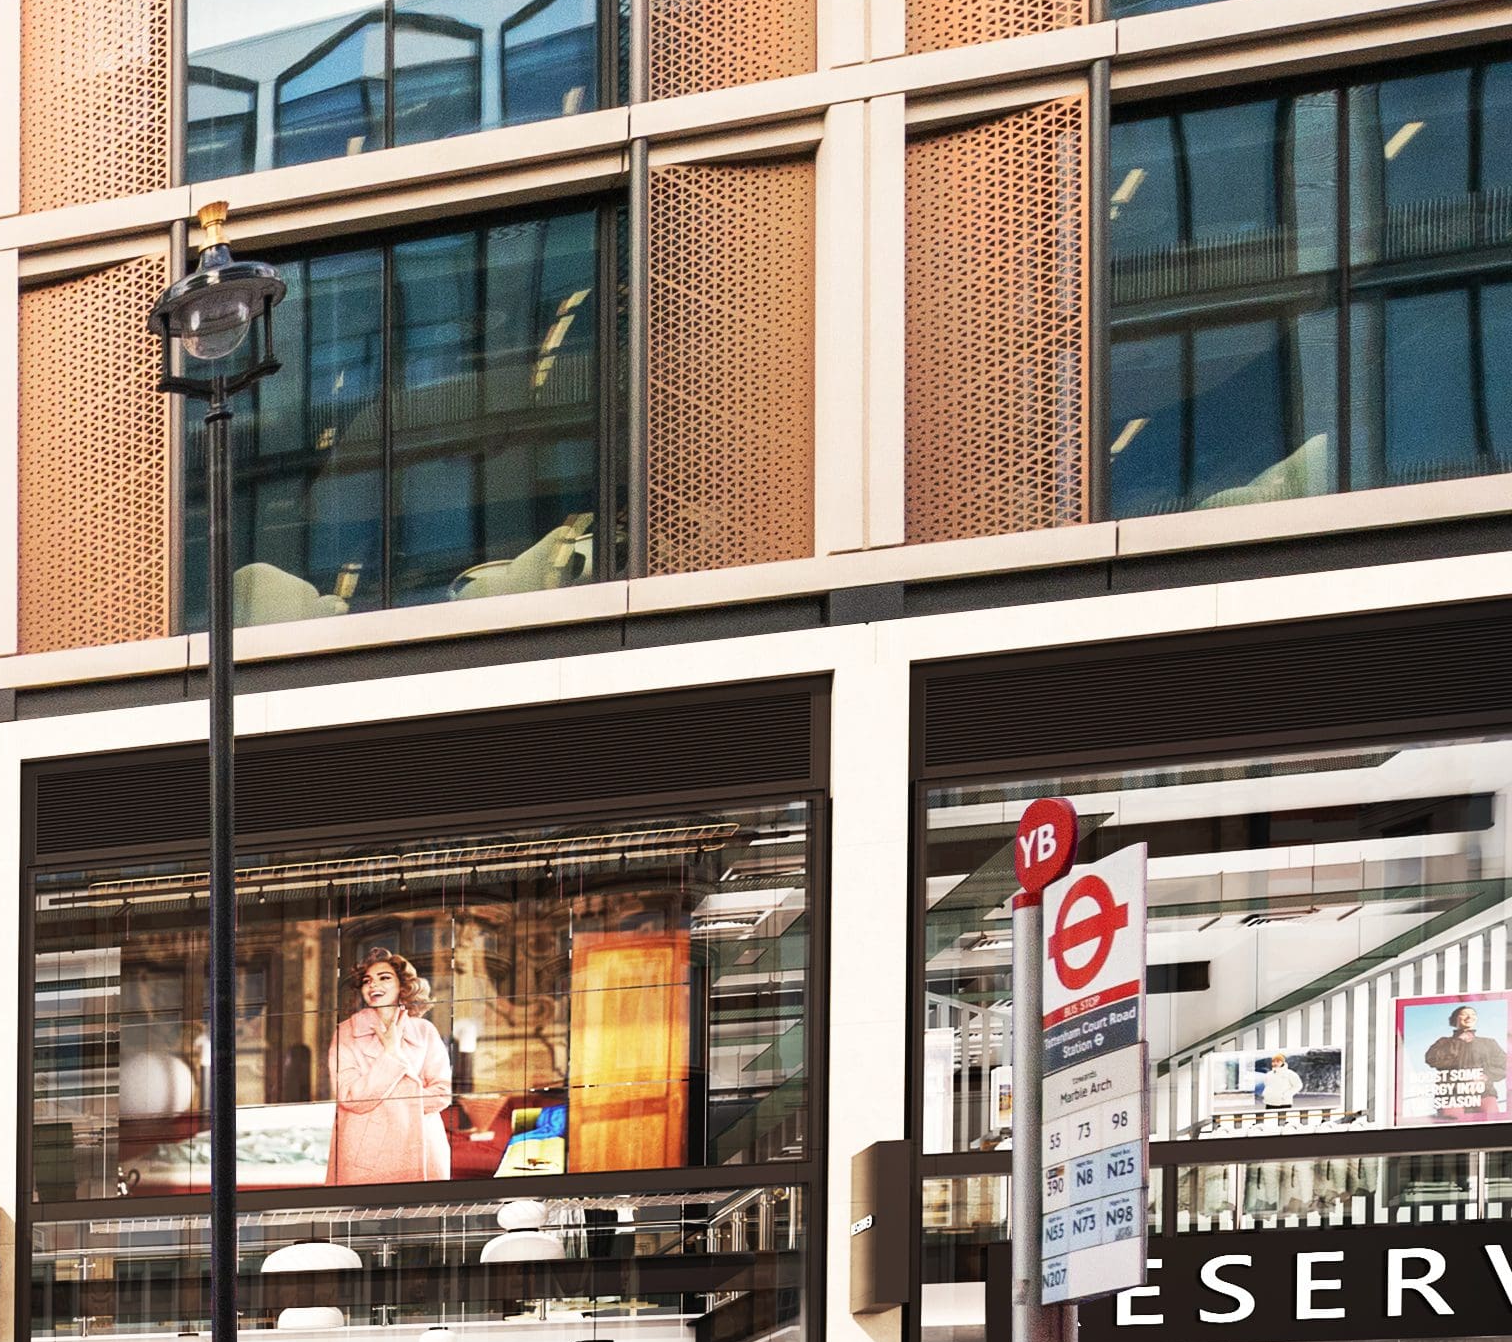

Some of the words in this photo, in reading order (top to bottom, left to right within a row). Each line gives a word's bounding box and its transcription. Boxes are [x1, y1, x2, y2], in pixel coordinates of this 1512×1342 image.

[1019, 823, 1058, 869] YB
[1064, 1004, 1078, 1017] BUS
[1080, 995, 1100, 1010] STOP
[1082, 1017, 1108, 1035] Court
[1109, 1006, 1136, 1025] Road
[1063, 1039, 1093, 1058] Station
[1450, 1068, 1484, 1081] SOME
[1060, 1087, 1088, 1105] Marble
[1090, 1079, 1112, 1094] Arch
[1457, 1081, 1485, 1095] INTO
[1433, 1095, 1482, 1109] SEASON
[1049, 1132, 1061, 1150] 55
[1077, 1122, 1091, 1141] 73
[1112, 1111, 1128, 1130] 98
[1047, 1177, 1064, 1197] 390
[1076, 1168, 1093, 1187] N8
[1107, 1157, 1134, 1179] N25
[1045, 1223, 1064, 1243] N55
[1073, 1214, 1096, 1235] N73
[1106, 1206, 1133, 1227] N98
[1043, 1268, 1067, 1289] N207
